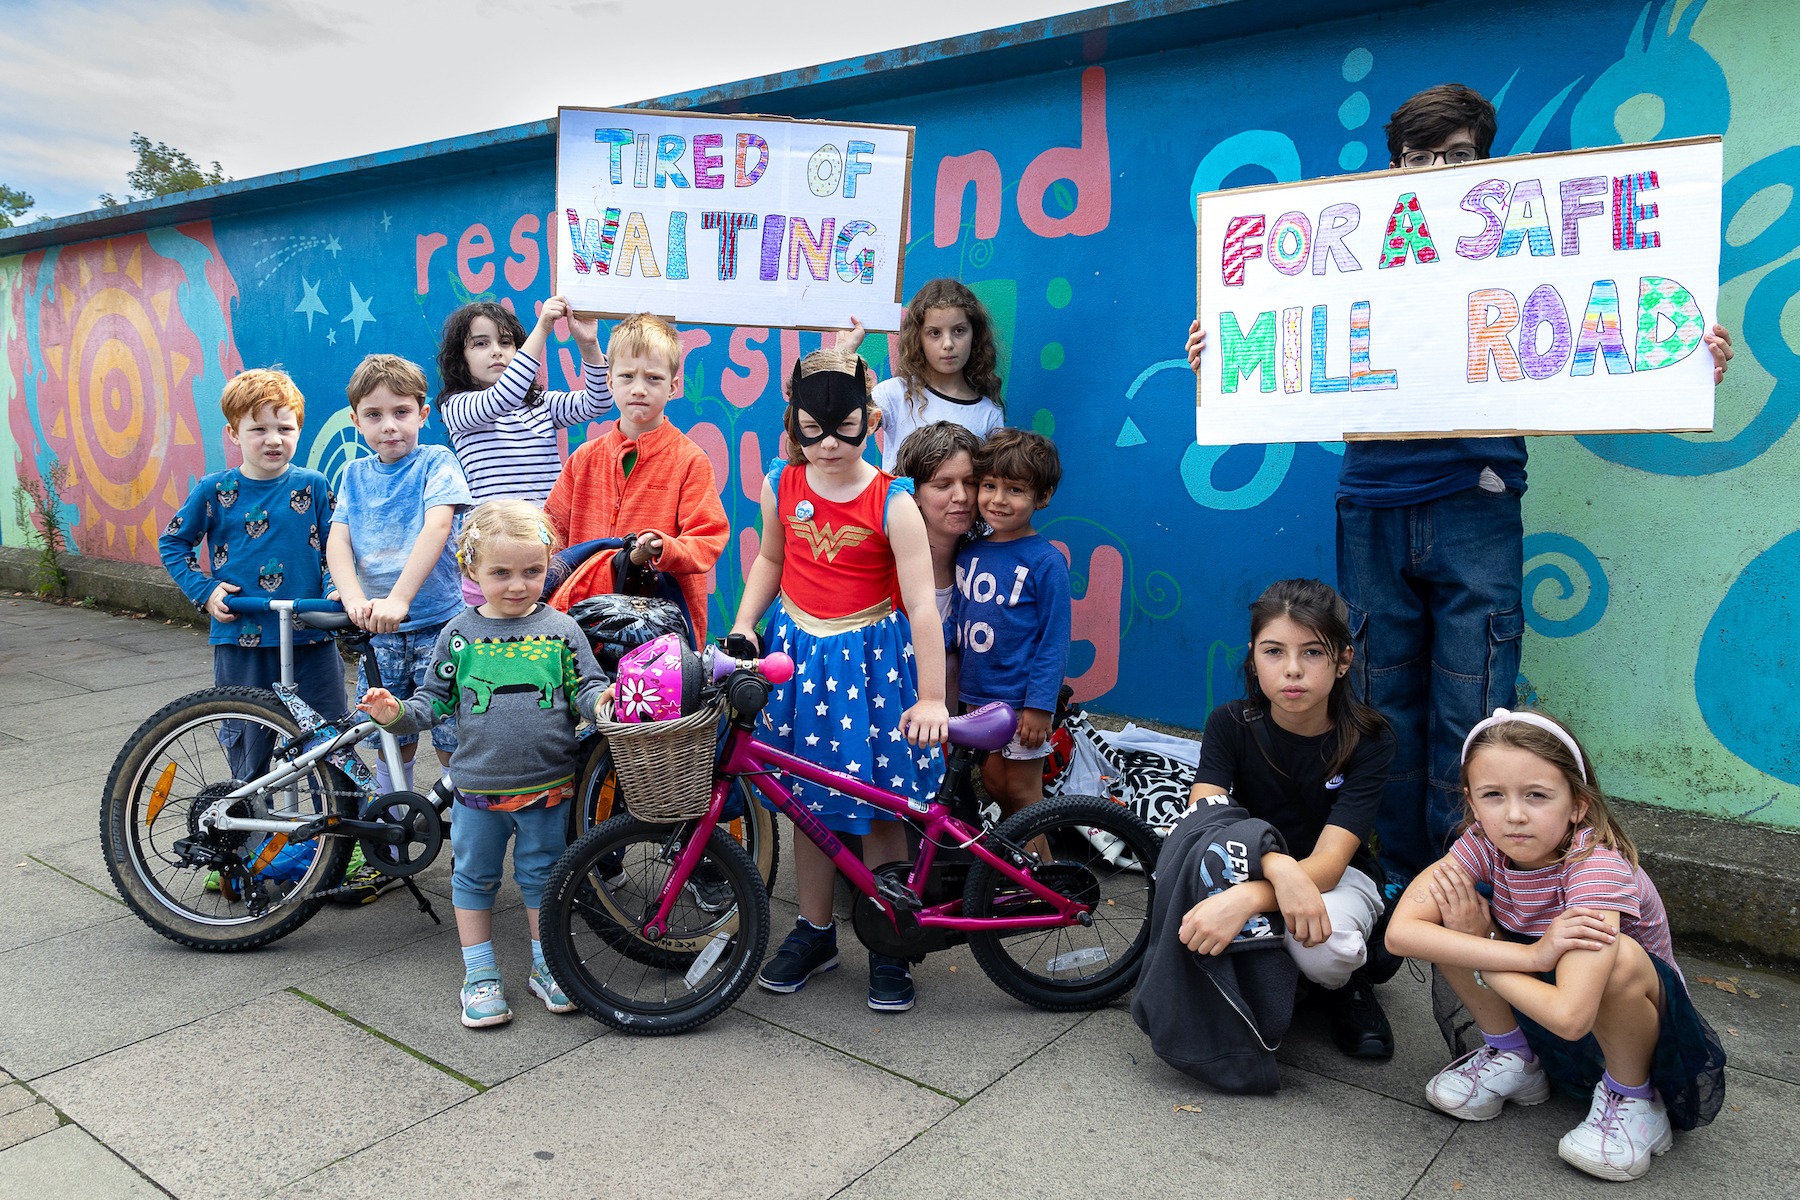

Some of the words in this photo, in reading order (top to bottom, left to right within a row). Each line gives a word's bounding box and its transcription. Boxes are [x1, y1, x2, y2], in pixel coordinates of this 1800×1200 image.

[416, 213, 557, 297] res
[905, 66, 1112, 248] nd
[594, 127, 770, 190] TIRED
[807, 140, 876, 198] OF
[566, 207, 878, 285] WAITING
[1221, 202, 1361, 287] FOR
[1379, 192, 1440, 269] A
[1456, 170, 1662, 260] SAFE
[1219, 301, 1398, 395] MILL
[1467, 275, 1705, 384] ROAD
[557, 870, 575, 900] KENDA
[661, 940, 697, 948] KEN
